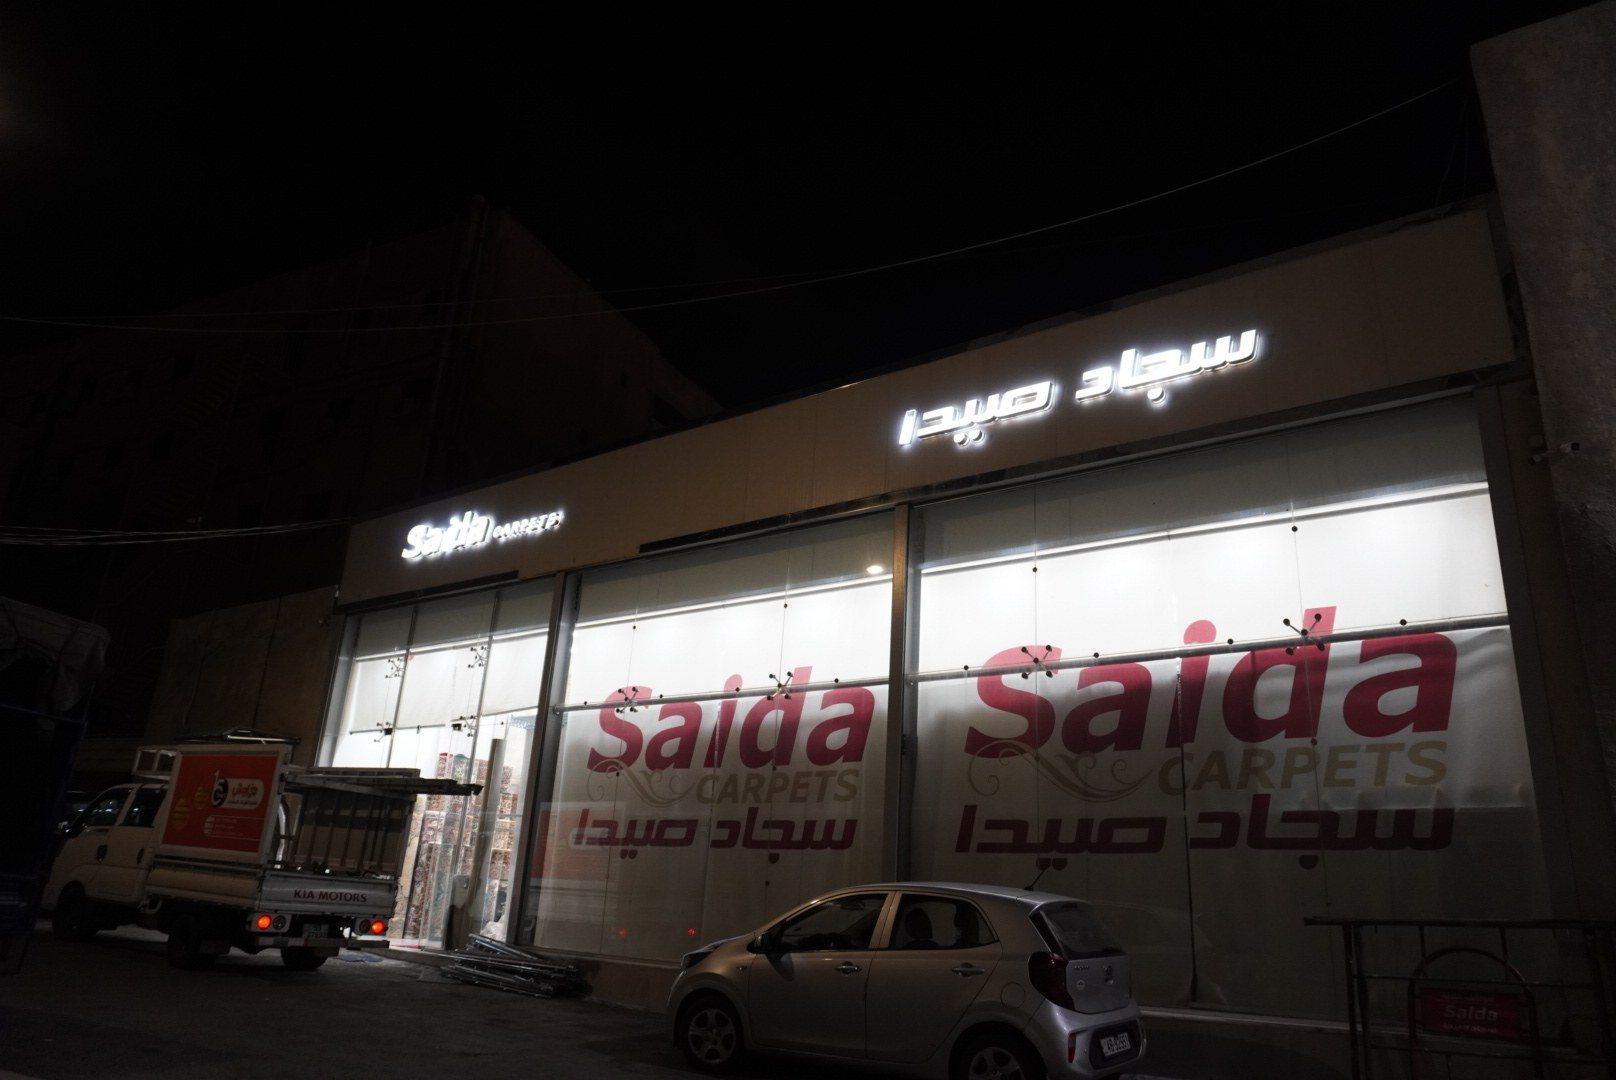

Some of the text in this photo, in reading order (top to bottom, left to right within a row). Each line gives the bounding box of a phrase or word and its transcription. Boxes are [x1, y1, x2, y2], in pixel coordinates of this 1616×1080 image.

[898, 329, 1258, 447] سجاد صيدا
[401, 510, 563, 559] Saida CARPETS
[963, 606, 1458, 758] Saida
[586, 666, 875, 773] Saida
[696, 768, 860, 804] CARPETS
[1158, 740, 1448, 796] CARPETS
[573, 807, 858, 864] سجاد صيدا
[954, 794, 1456, 871] سجاد صيدا
[293, 889, 368, 903] KIA MOTORS
